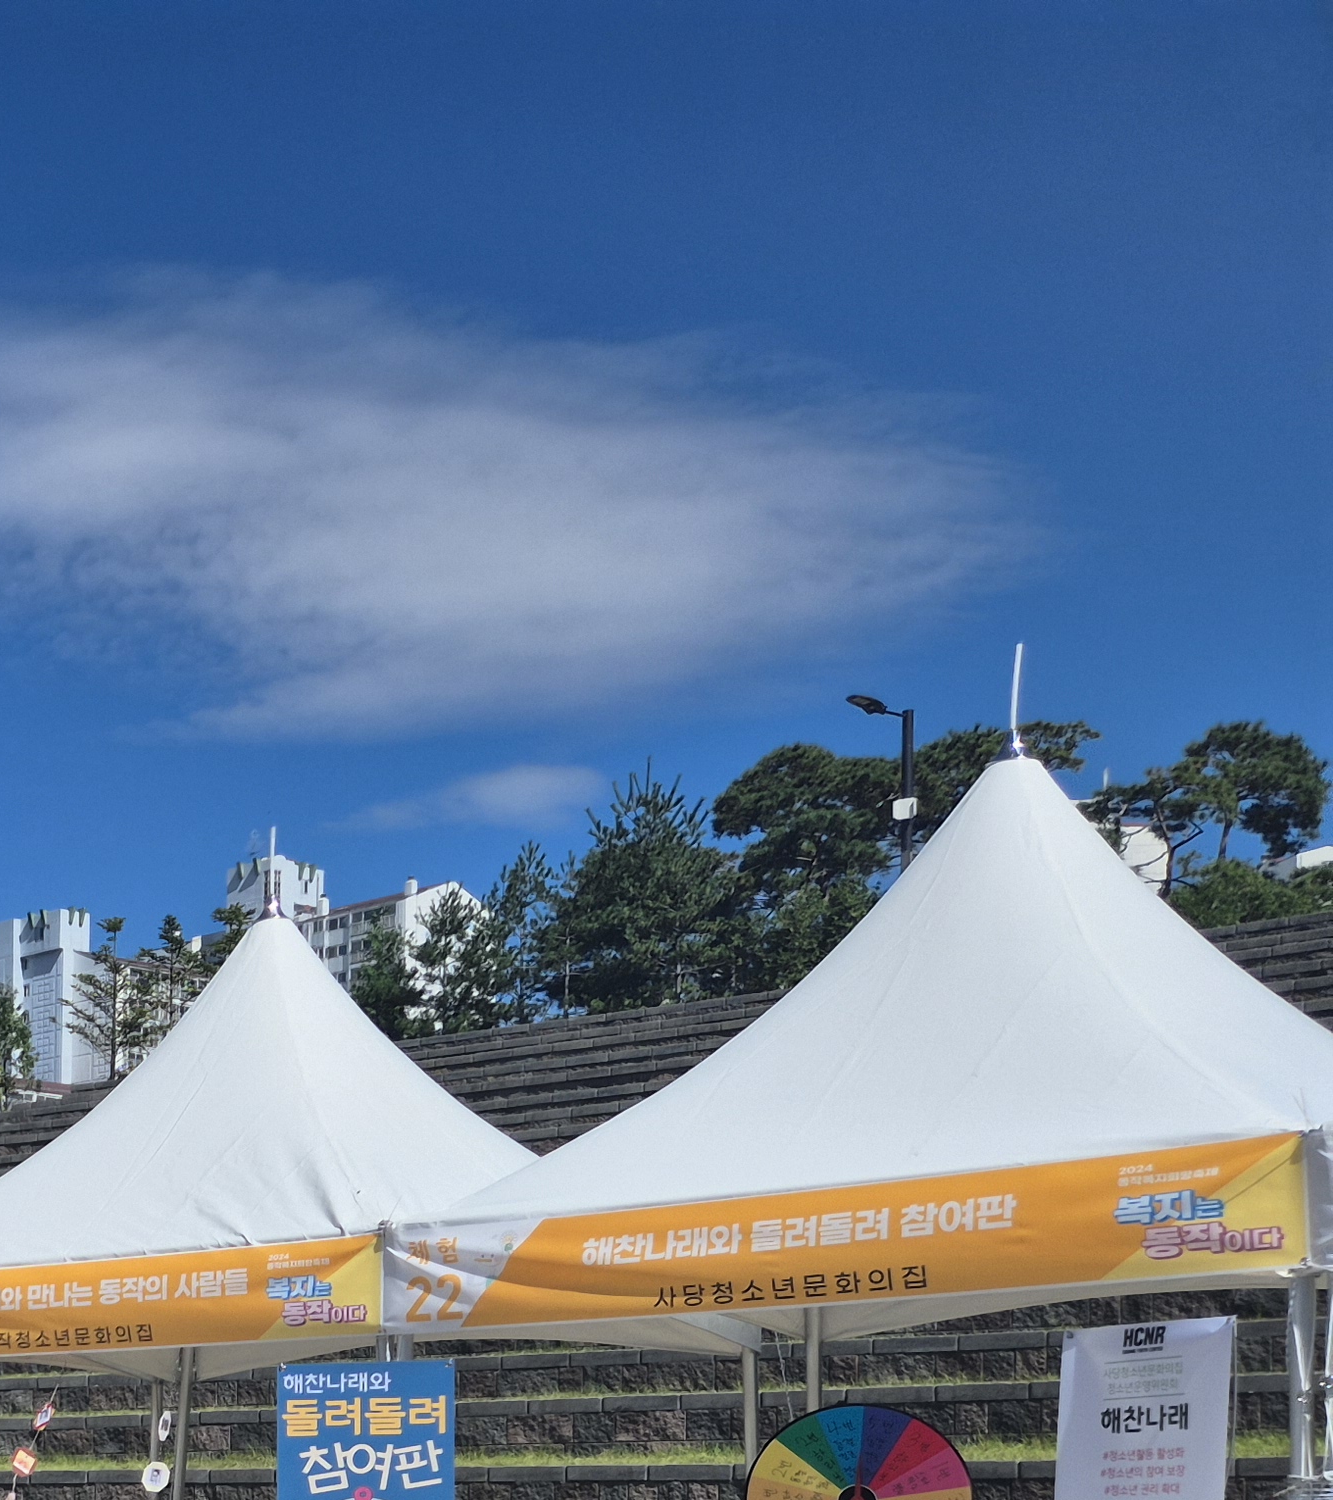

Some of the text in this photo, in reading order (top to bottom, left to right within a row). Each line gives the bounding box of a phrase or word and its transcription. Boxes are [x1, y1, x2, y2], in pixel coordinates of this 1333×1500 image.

[1118, 1163, 1154, 1176] 2024
[1113, 1188, 1225, 1226] 복지는
[581, 1193, 1018, 1267] 해찬나래와 돌려돌려 참여판
[1141, 1220, 1285, 1260] 동작이다
[405, 1236, 459, 1266] 체험
[27, 1282, 93, 1311] 만나는
[98, 1274, 169, 1305] 동작의
[174, 1267, 249, 1299] 사람들
[265, 1275, 332, 1300] 복지는
[405, 1273, 464, 1323] 22
[653, 1264, 930, 1309] 사당청소년문화의집
[281, 1299, 368, 1327] 동작이다
[1122, 1325, 1166, 1348] HCNR
[282, 1371, 392, 1395] 해찬나래와
[1103, 1361, 1183, 1380] 사당청소년문화의집
[282, 1395, 447, 1437] 돌려돌려
[1100, 1403, 1189, 1434] 해찬나래
[298, 1439, 444, 1495] 참여판
[1100, 1464, 1186, 1480] #청소년의 참여 보장
[1103, 1484, 1138, 1497] #청소년
